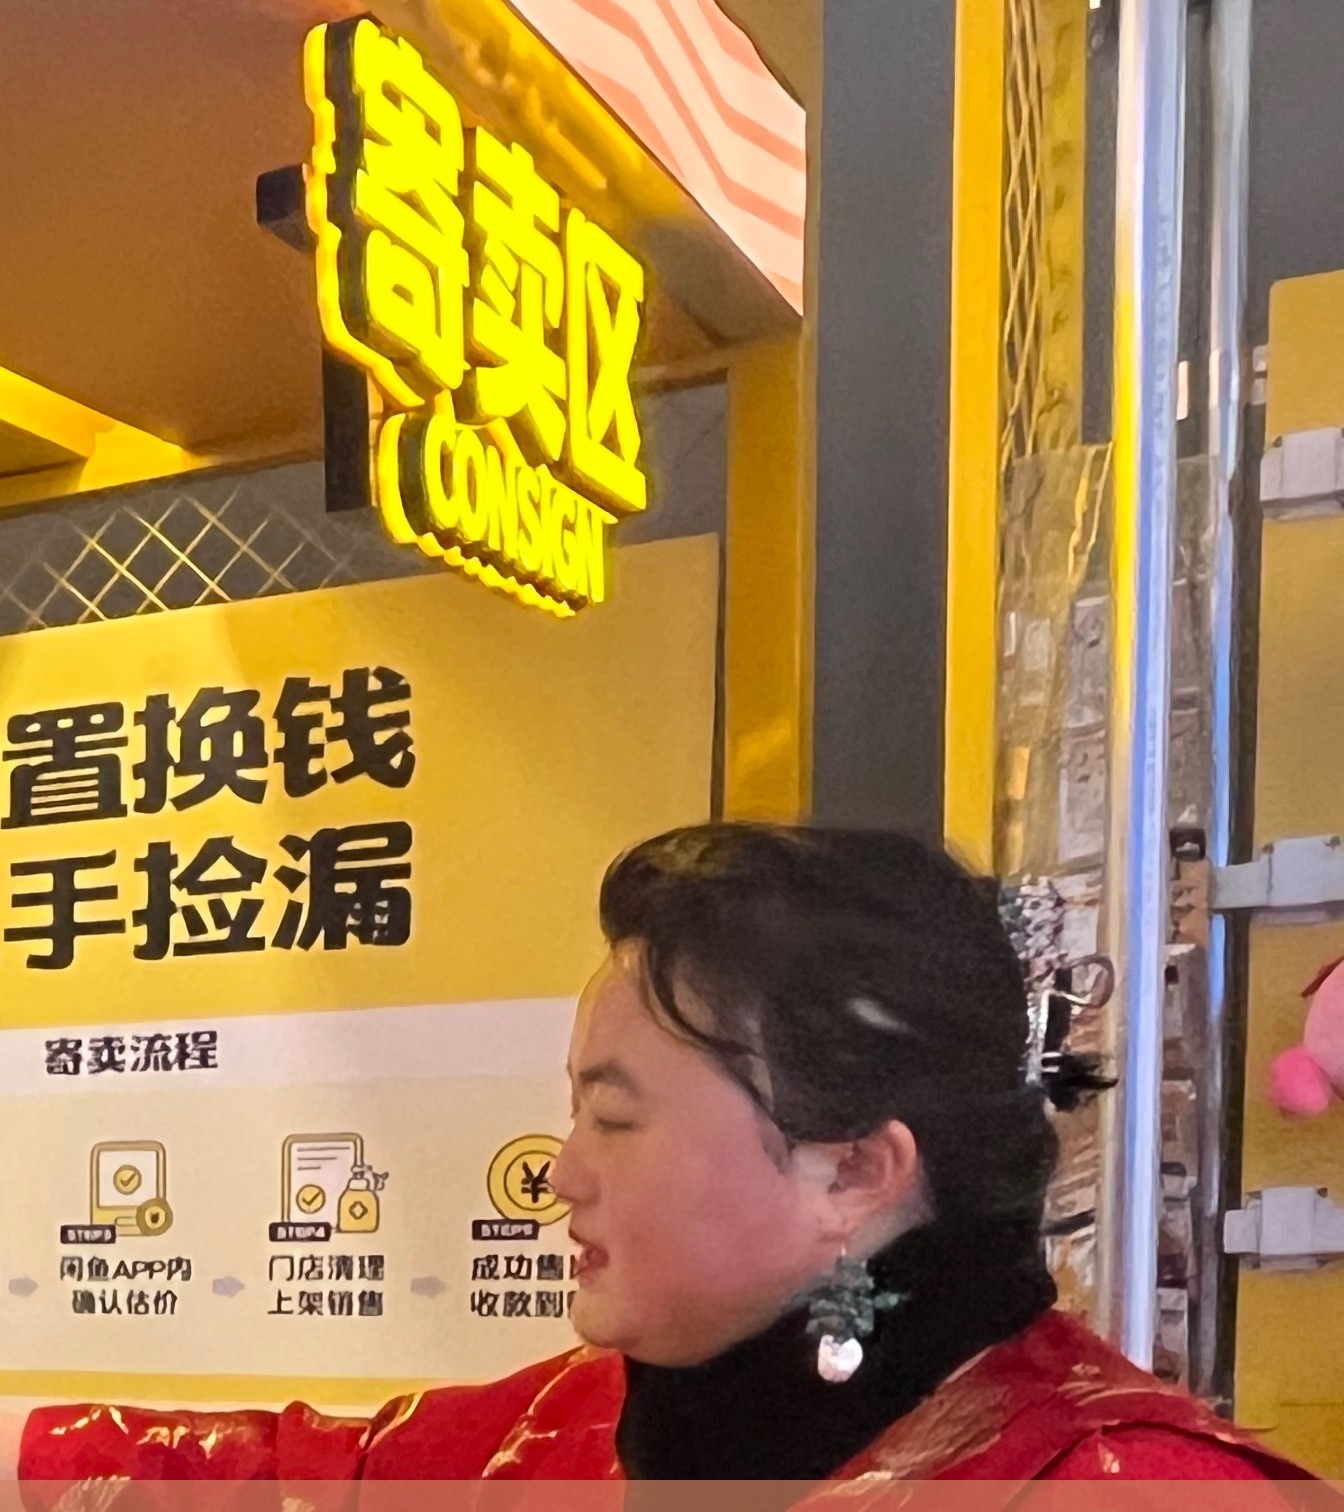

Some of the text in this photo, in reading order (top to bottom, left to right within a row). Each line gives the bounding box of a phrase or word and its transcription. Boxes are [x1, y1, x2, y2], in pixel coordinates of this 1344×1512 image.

[353, 17, 647, 512] 寄卖区
[424, 413, 605, 603] CONSIGN
[44, 1030, 219, 1076] 寄卖流程
[471, 1253, 575, 1281] 成功售
[470, 1289, 577, 1319] 收款到
